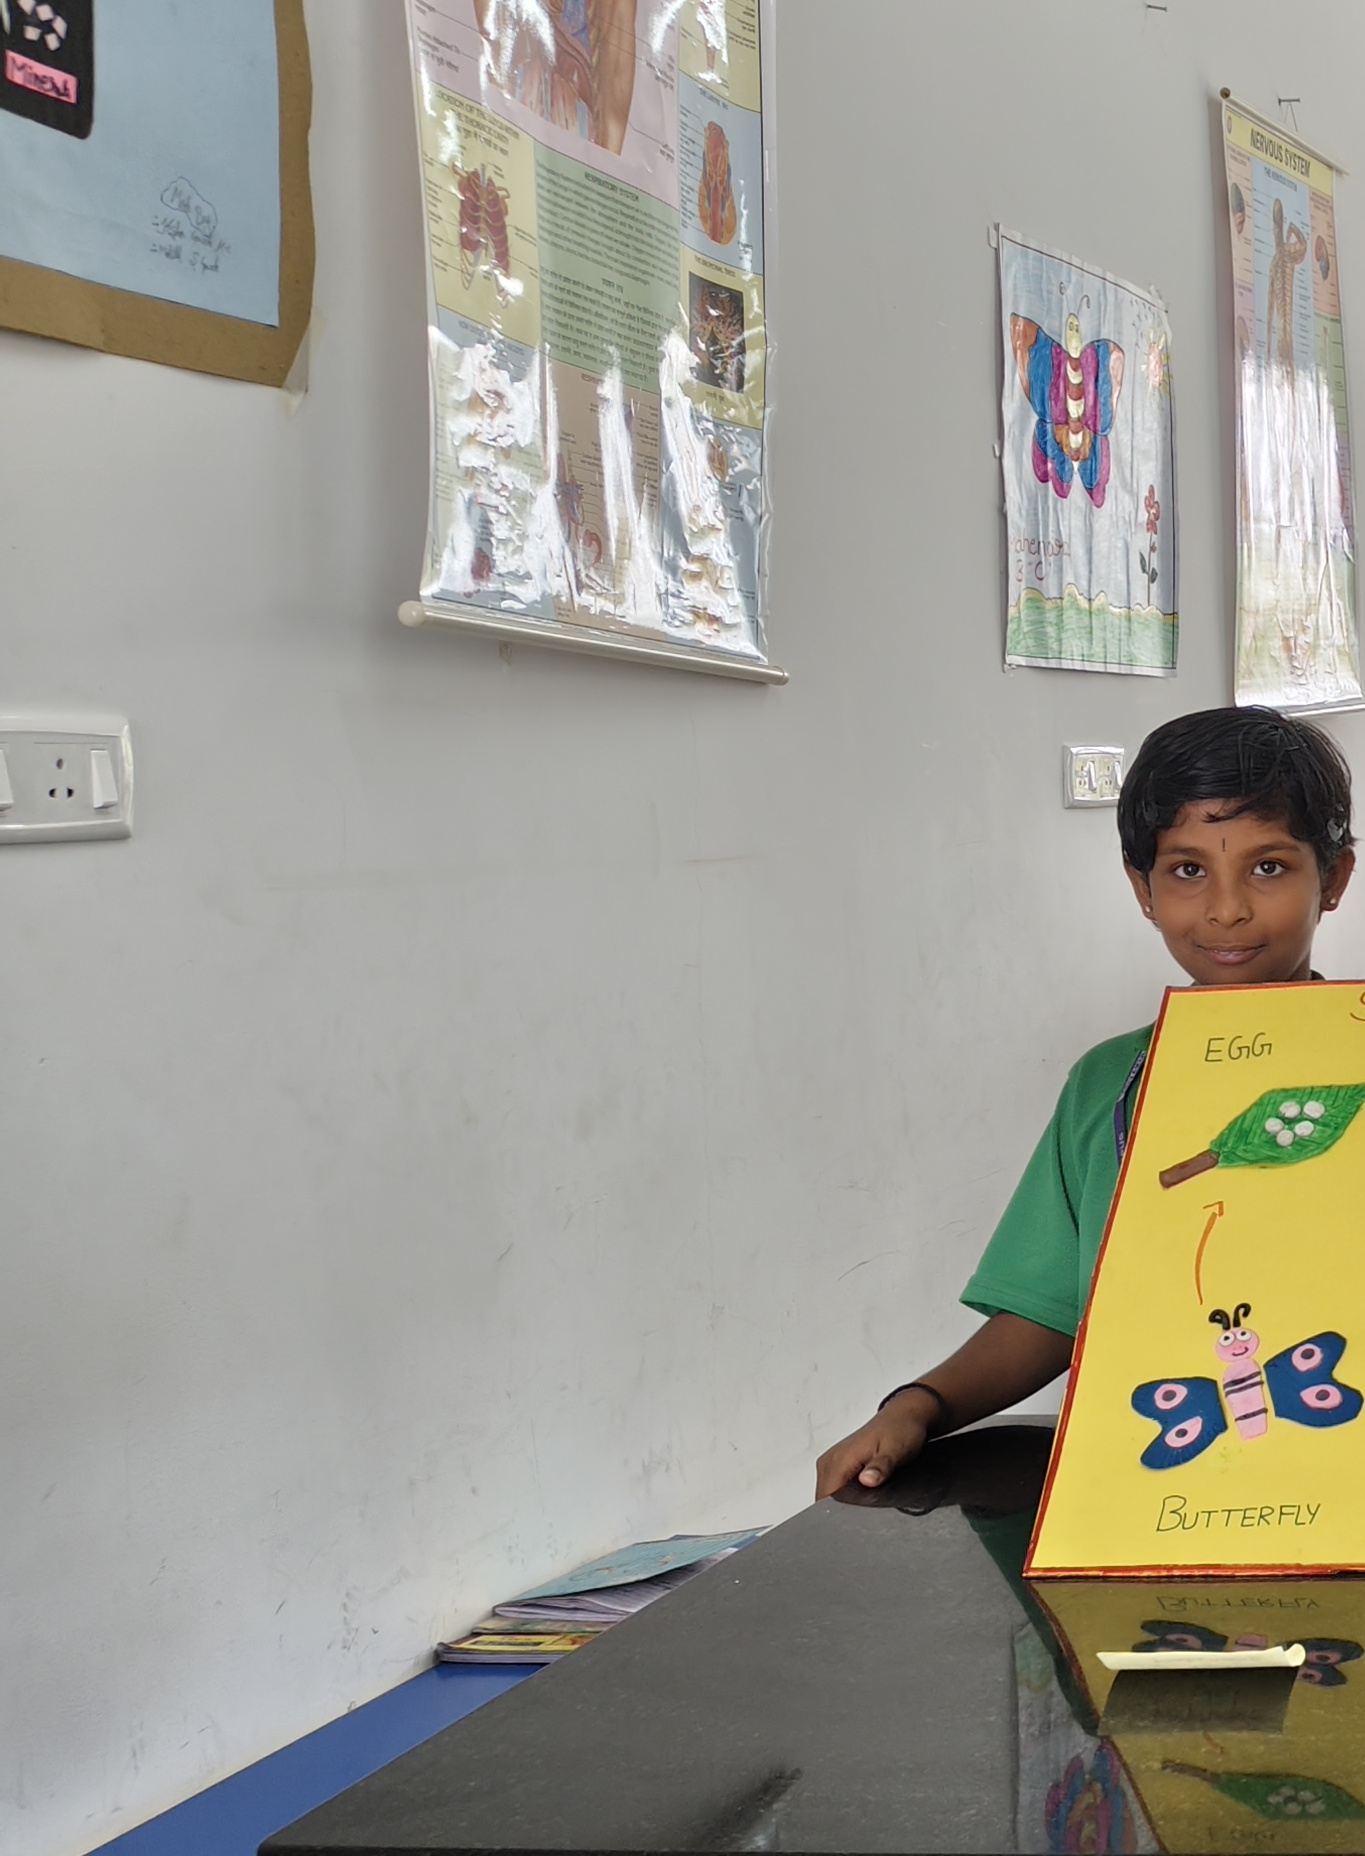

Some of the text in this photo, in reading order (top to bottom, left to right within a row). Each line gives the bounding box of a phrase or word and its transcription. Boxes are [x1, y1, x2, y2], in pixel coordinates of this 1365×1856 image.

[1250, 128, 1284, 163] NERVOUS
[1284, 147, 1311, 178] SYSTEM
[1204, 1032, 1273, 1063] EGG
[1155, 1494, 1322, 1532] BUTTERFLY
